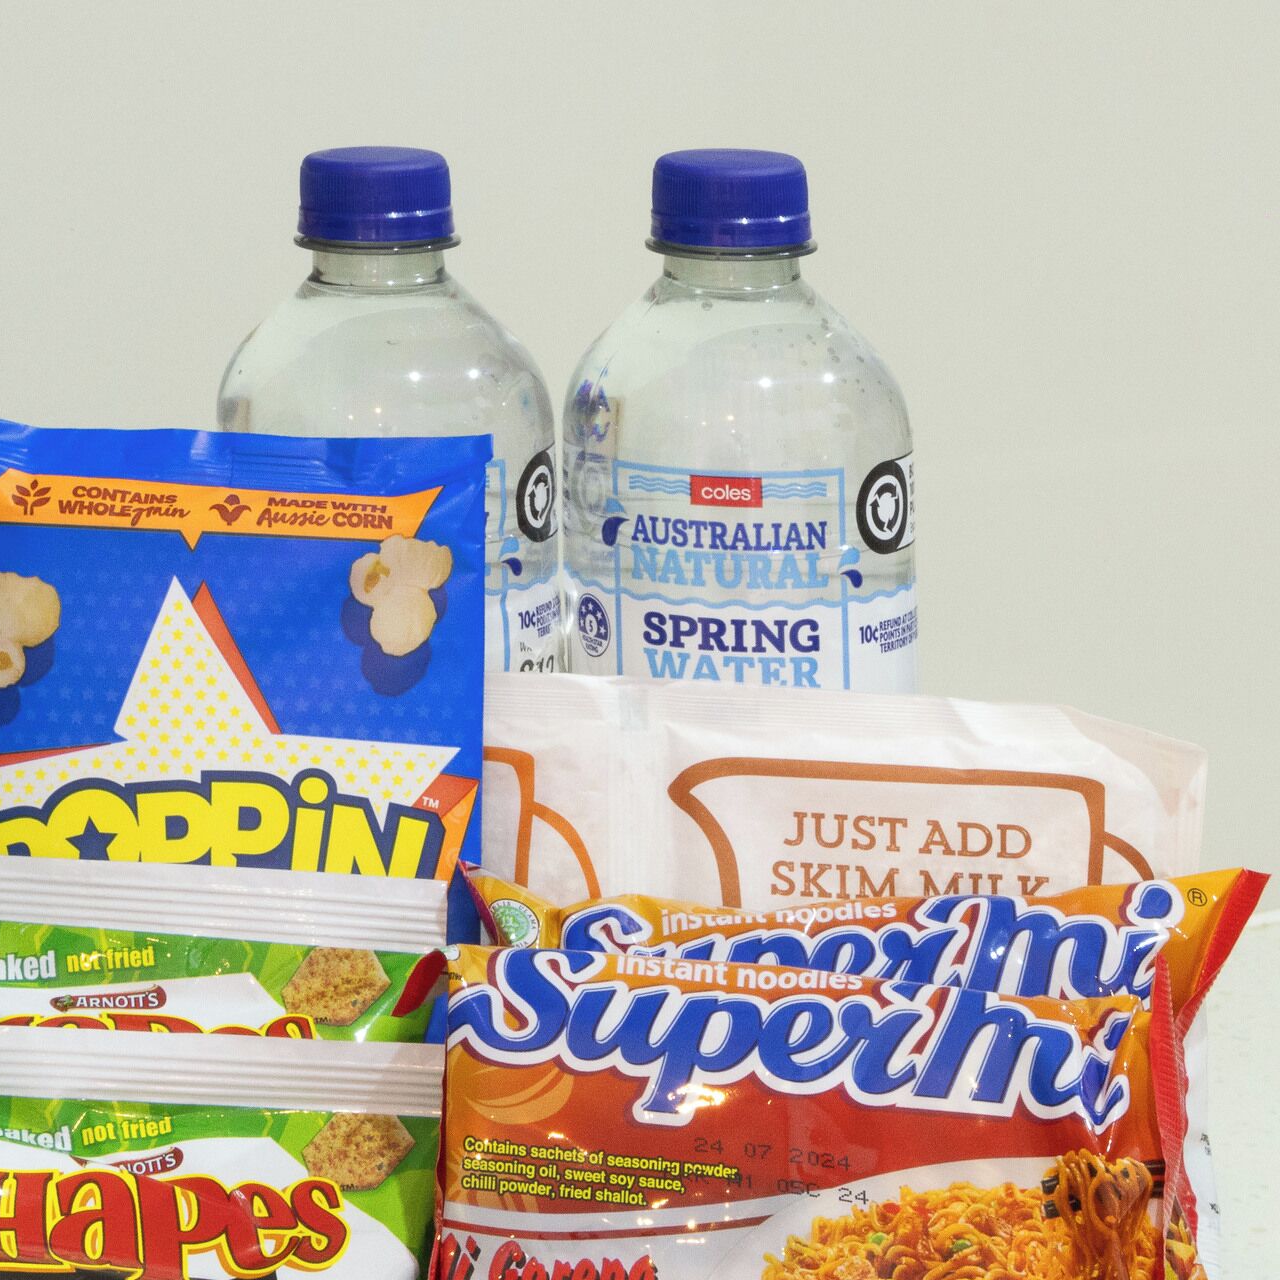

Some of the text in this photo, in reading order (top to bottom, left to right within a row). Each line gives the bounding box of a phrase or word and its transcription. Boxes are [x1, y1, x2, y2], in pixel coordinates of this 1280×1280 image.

[71, 484, 178, 505] CONTAINS
[266, 496, 388, 514] MADE WITH
[700, 484, 752, 502] coles
[255, 506, 394, 530] Aussie CORN
[631, 513, 828, 551] AUSTRALIAN
[630, 544, 830, 590] NATURAL
[642, 611, 821, 654] SPRING
[643, 648, 821, 688] WATER
[783, 811, 1032, 859] JUST ADD
[770, 861, 900, 899] SKIM
[775, 902, 898, 924] noodles
[66, 953, 103, 974] not
[105, 945, 156, 969] fried
[616, 953, 864, 992] instant noodles
[75, 991, 160, 1010] ARNOTT'S
[81, 1123, 116, 1147] not
[119, 1115, 173, 1142] fried
[464, 1137, 527, 1157] Contains
[530, 1145, 586, 1164] sachets
[589, 1152, 605, 1166] of
[606, 1154, 680, 1176] seasoning
[694, 1137, 851, 1170] 24 07 2024
[462, 1175, 648, 1207] chilli powder, fried shallot.
[463, 1157, 536, 1180] seasoning
[539, 1163, 561, 1182] oil,
[564, 1168, 606, 1185] sweet
[609, 1173, 635, 1189] soy
[638, 1175, 686, 1194] sauce,
[838, 1186, 869, 1205] 24
